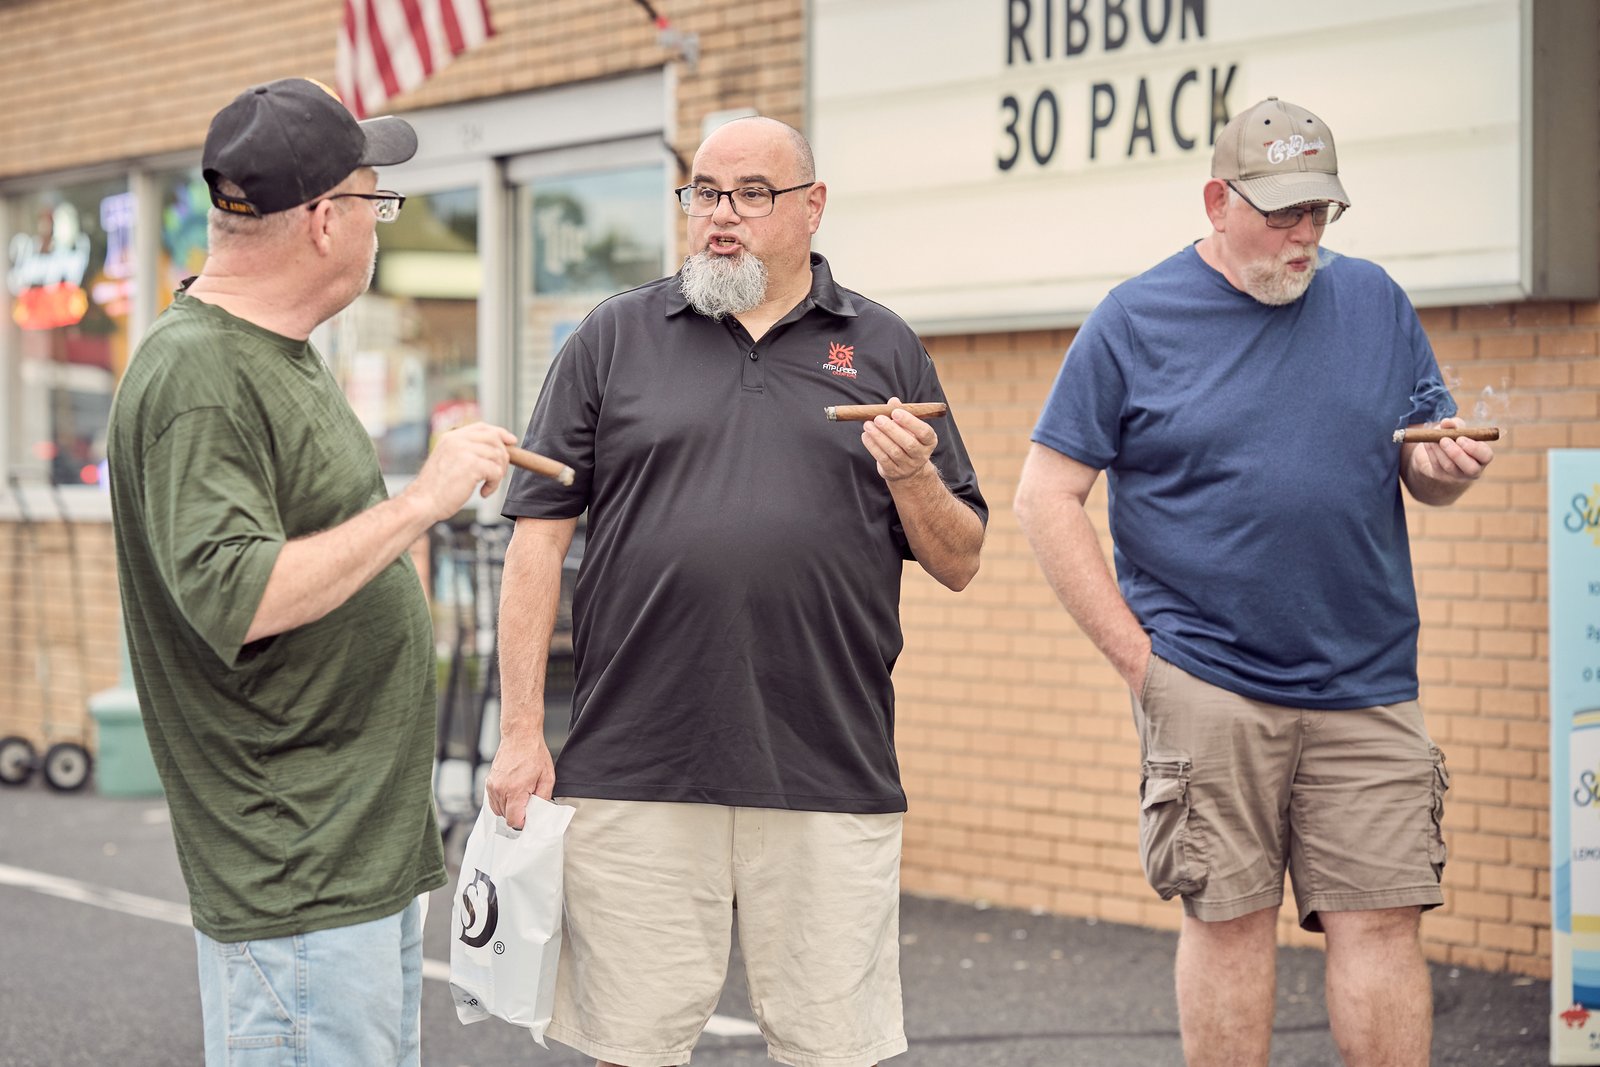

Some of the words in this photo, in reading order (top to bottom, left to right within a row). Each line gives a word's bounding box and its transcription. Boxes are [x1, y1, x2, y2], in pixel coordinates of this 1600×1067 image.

[1005, 0, 1207, 65] RIBBON
[997, 89, 1060, 171] 30
[1089, 64, 1239, 160] PACK
